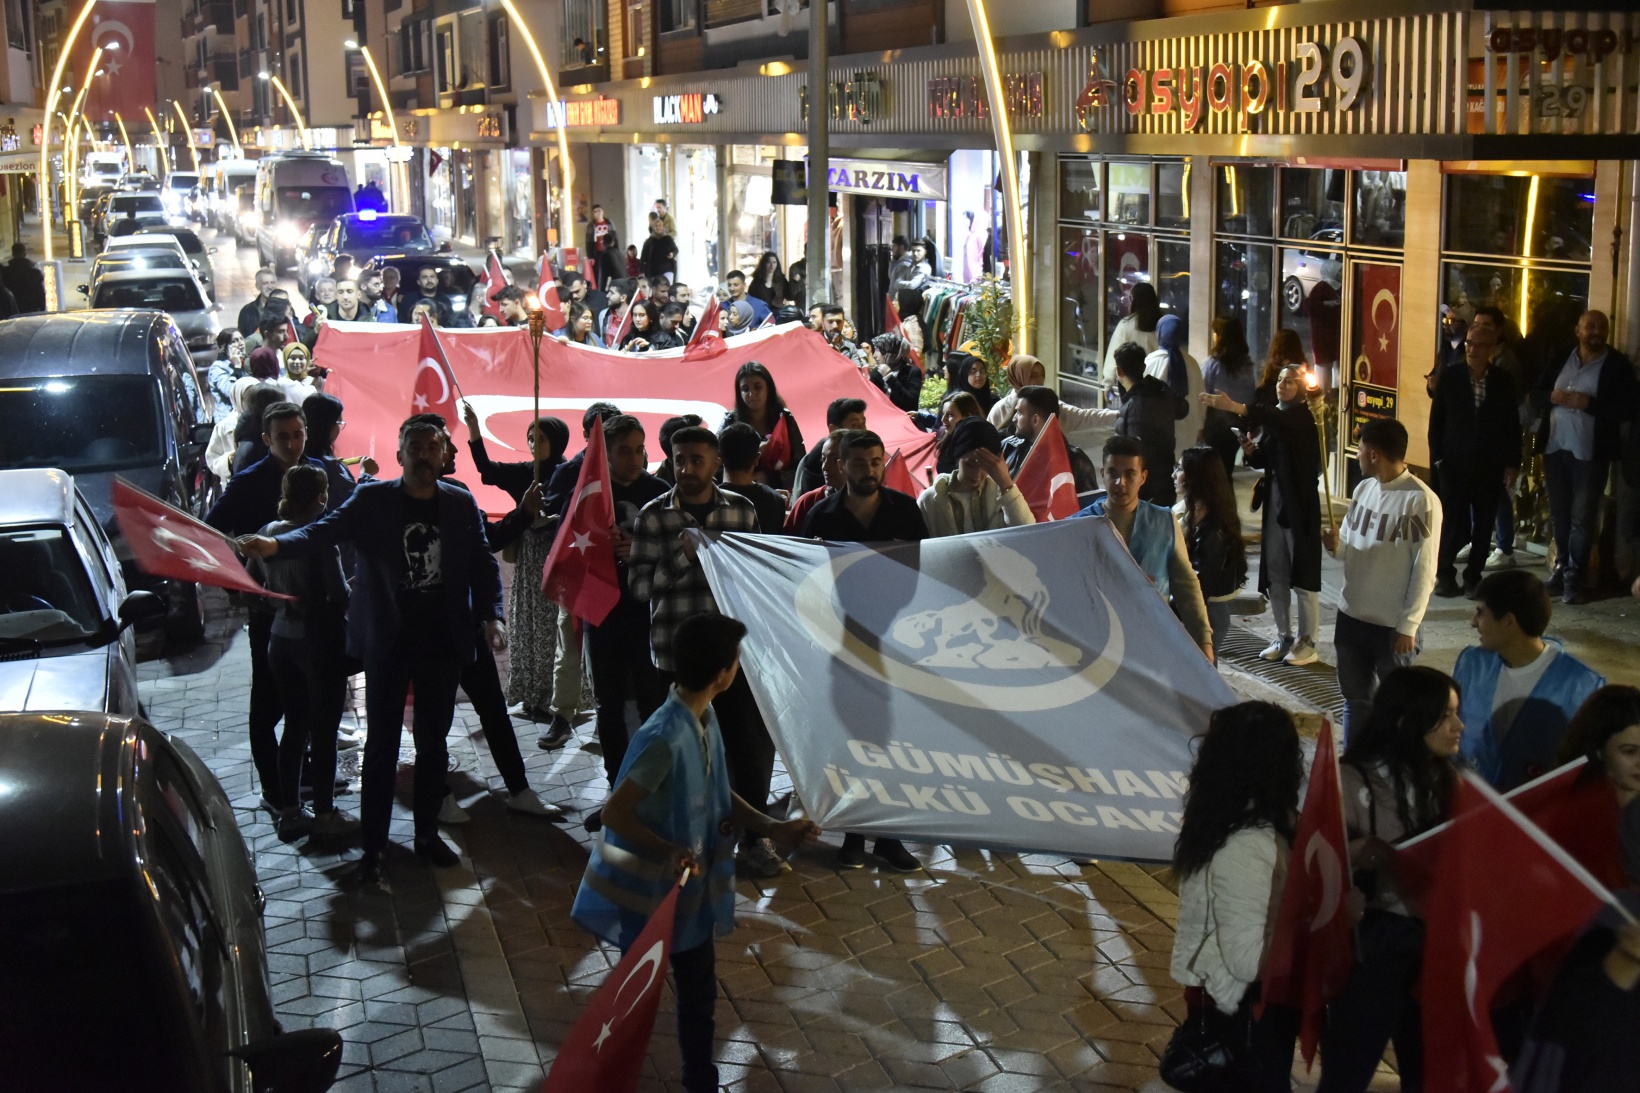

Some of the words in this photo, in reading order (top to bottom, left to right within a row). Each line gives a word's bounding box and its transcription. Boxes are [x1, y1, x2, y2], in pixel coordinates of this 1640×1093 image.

[1294, 36, 1369, 113] 29
[1540, 84, 1588, 117] 29
[823, 763, 992, 816] ÜLKÜ
[1006, 796, 1185, 834] OCAK
[846, 739, 1191, 799] GÜMÜŞHAN
